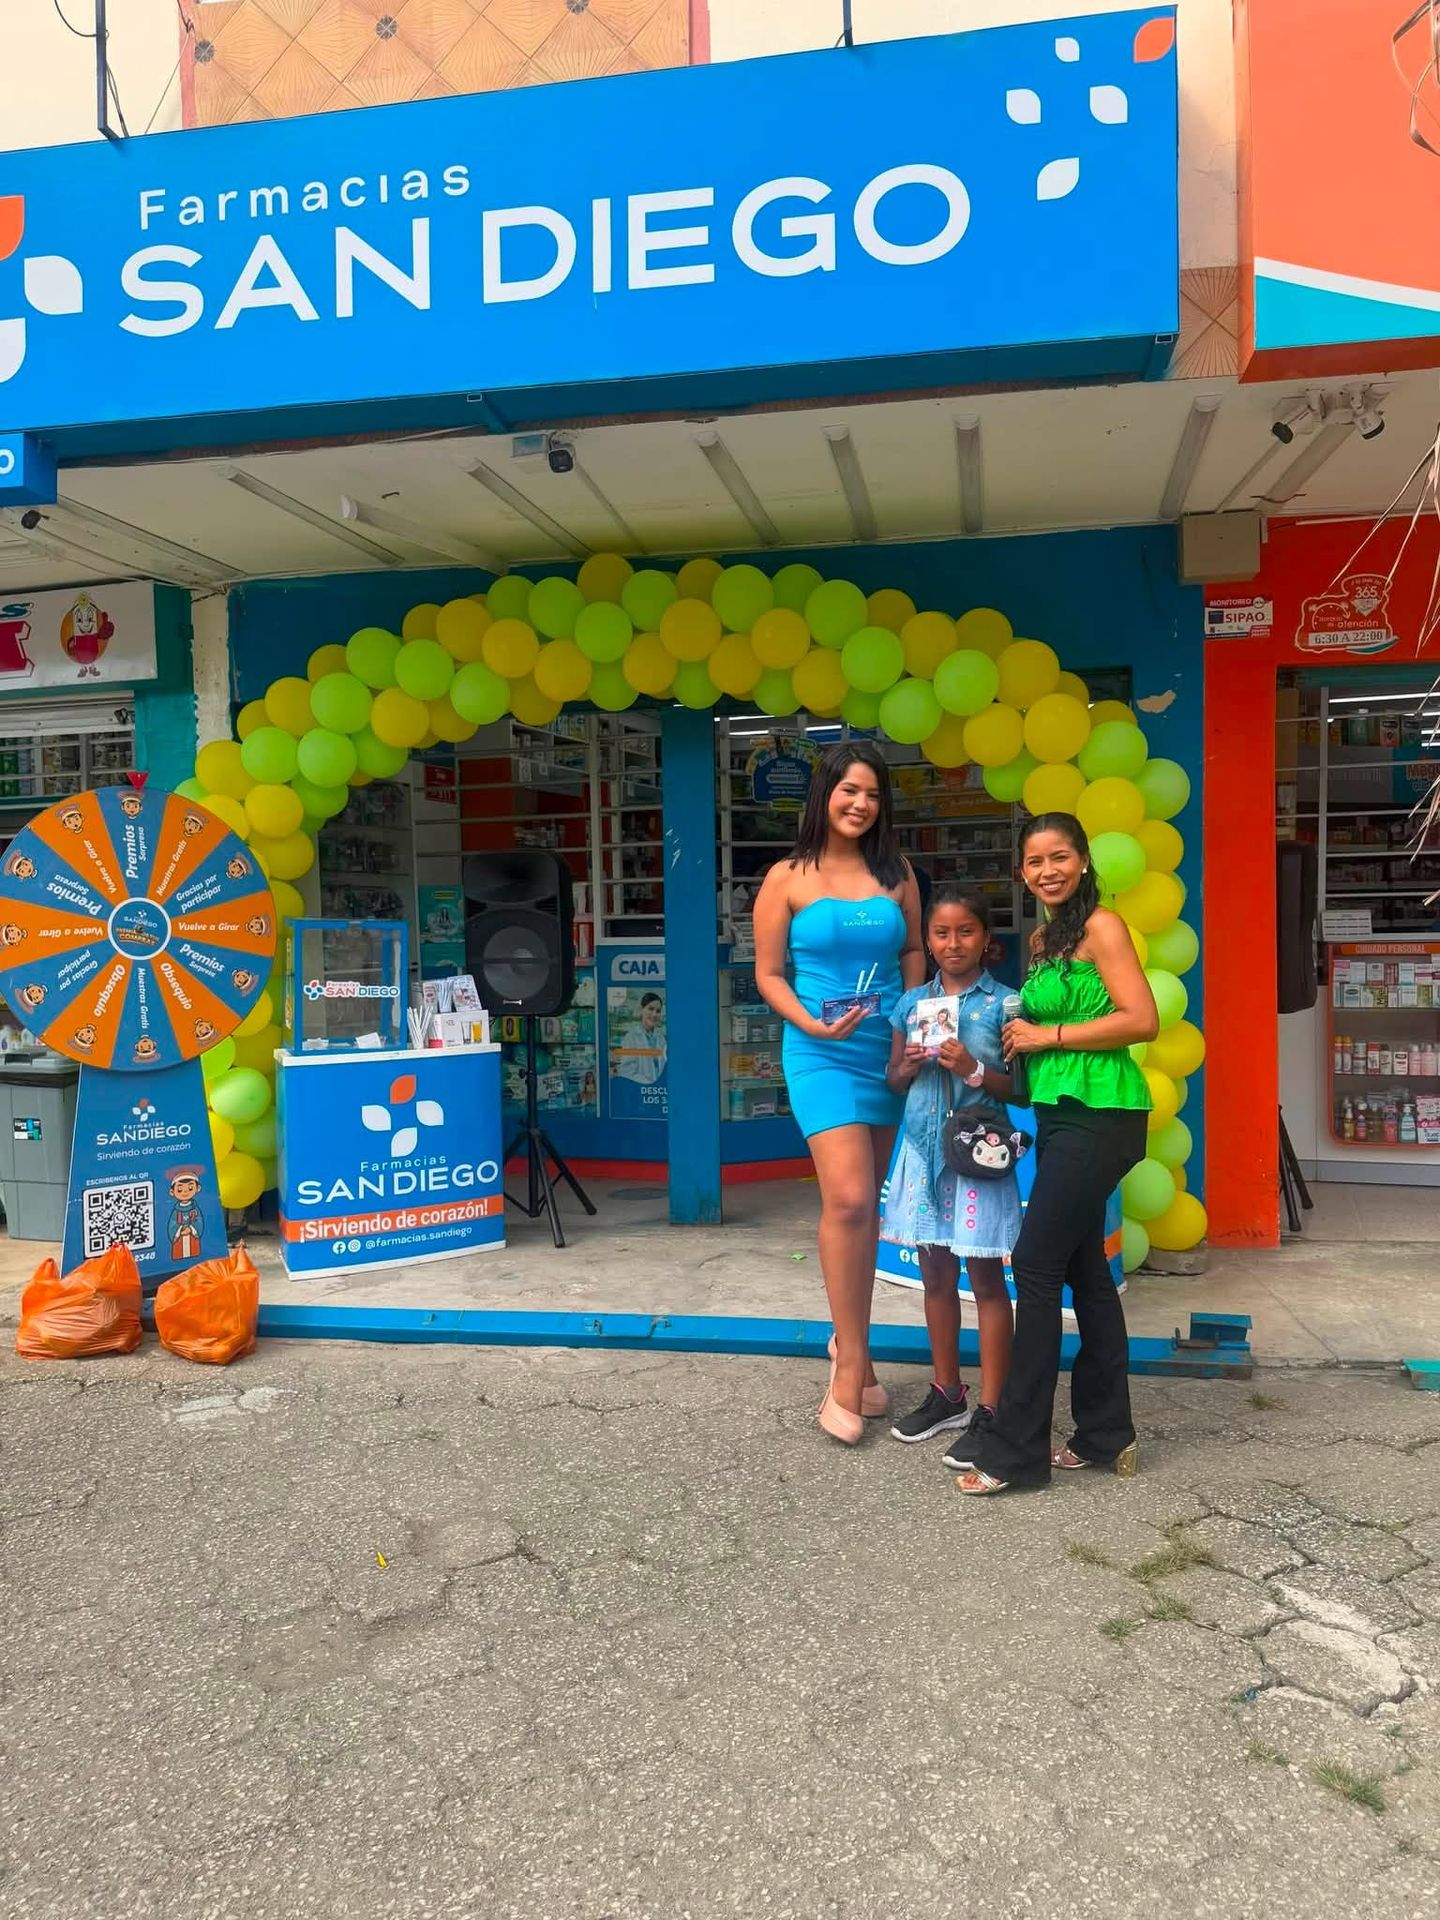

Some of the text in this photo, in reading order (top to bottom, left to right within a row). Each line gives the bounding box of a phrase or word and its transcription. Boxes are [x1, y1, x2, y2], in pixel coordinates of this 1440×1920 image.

[139, 165, 470, 231] Farmacias
[119, 163, 971, 338] SAN DIEGO
[1355, 586, 1377, 598] 365
[1225, 612, 1265, 623] SIPAO
[1315, 631, 1383, 644] 6:30 A 22:00
[124, 825, 139, 879] Premios
[46, 882, 103, 916] Premios
[176, 875, 218, 901] Gracias por
[181, 884, 222, 913] participar
[38, 928, 61, 937] Girar
[178, 922, 208, 931] Vuelve
[218, 923, 240, 931] Girar
[180, 943, 225, 972] Premios
[1388, 944, 1424, 953] PERSONAL
[58, 949, 91, 979] participar
[60, 960, 98, 992] Gracias por
[619, 960, 660, 975] CAJA
[93, 963, 126, 1017] Obsequio
[160, 962, 193, 1010] Obsequio
[138, 968, 150, 1029] Muestras Gratis
[643, 1096, 660, 1104] LOS
[96, 1124, 192, 1146] SANDIEGO
[97, 1142, 191, 1161] Sirviendo de corazón
[360, 1155, 447, 1173] Farmacias
[86, 1174, 128, 1186] ESCRIBENOS
[299, 1199, 489, 1243] ¡Sirviendo de corazón!
[365, 1226, 473, 1249] @farmacias.sandiego
